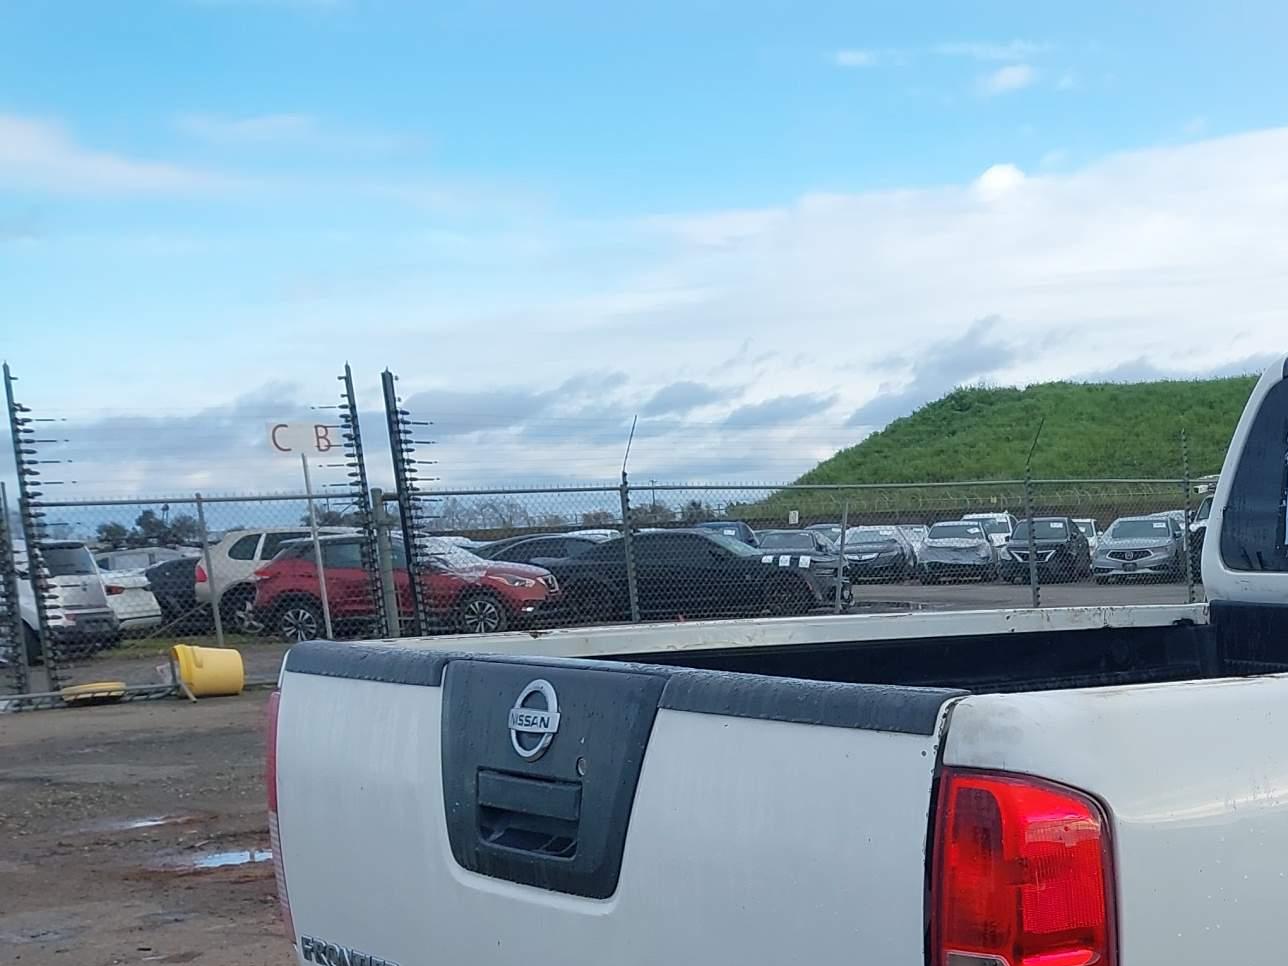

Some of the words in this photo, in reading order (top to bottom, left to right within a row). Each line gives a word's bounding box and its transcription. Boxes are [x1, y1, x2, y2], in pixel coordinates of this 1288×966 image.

[272, 424, 292, 452] C
[314, 424, 332, 452] B
[511, 712, 551, 729] NISSAN
